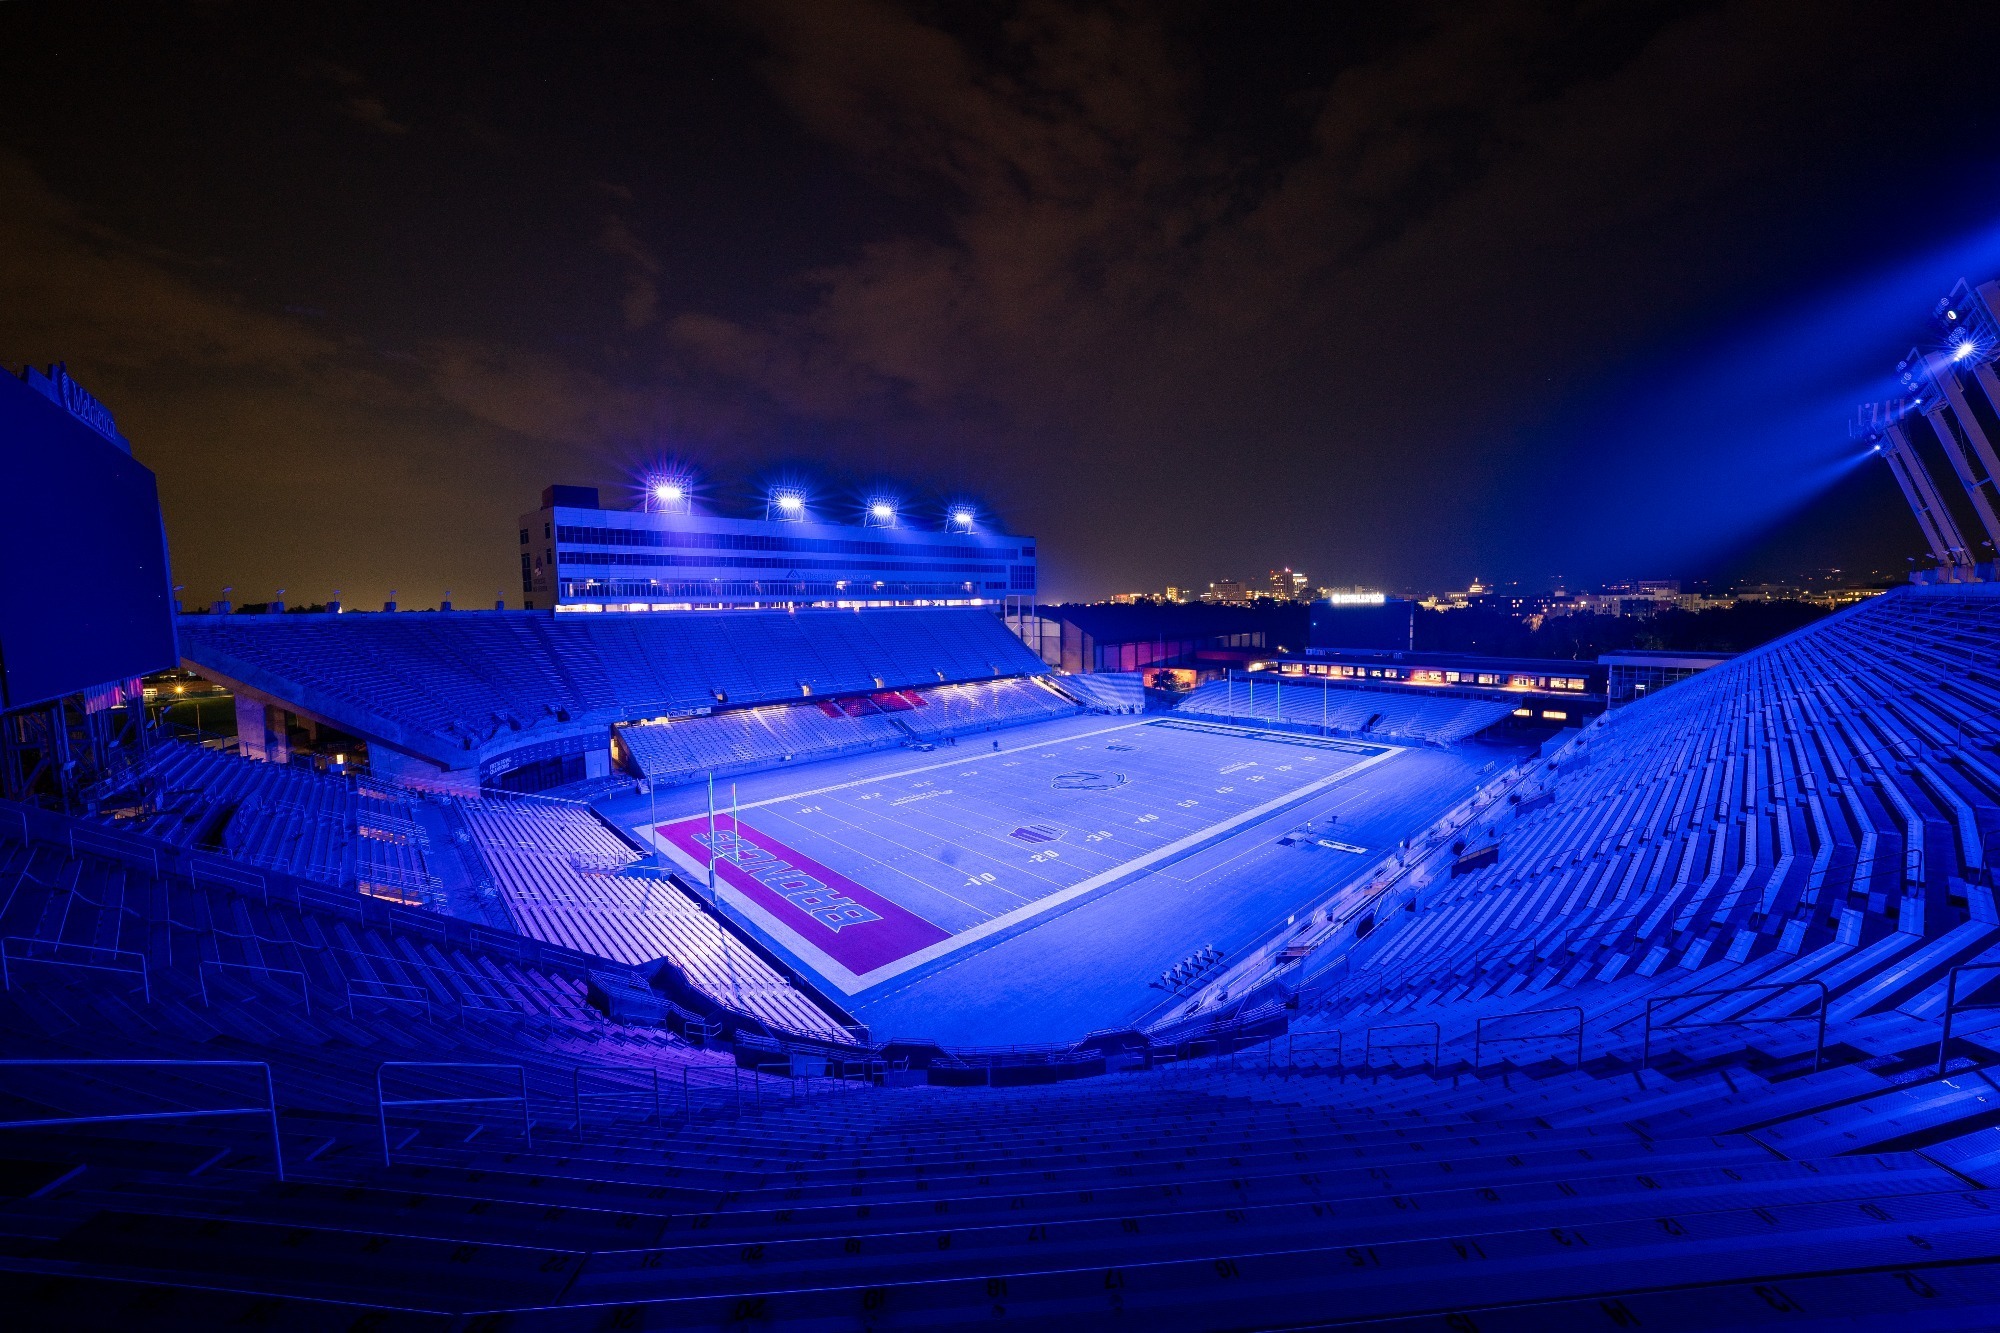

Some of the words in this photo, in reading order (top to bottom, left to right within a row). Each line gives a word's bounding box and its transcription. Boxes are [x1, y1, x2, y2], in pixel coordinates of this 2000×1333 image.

[1136, 812, 1160, 823] 40
[1088, 831, 1114, 843] 30
[1031, 850, 1060, 863] 20
[690, 830, 884, 933] BRONCOS
[966, 872, 997, 886] 10
[1367, 1167, 1391, 1181] 12
[1635, 1174, 1663, 1190] 10
[1162, 1184, 1184, 1198] 15
[1556, 1182, 1579, 1197] 11
[1009, 1197, 1026, 1211] 17
[1311, 1202, 1337, 1217] 14
[1391, 1196, 1421, 1211] 13
[1857, 1202, 1897, 1221] 10
[691, 1214, 714, 1230] 21
[773, 1209, 796, 1223] 20
[1225, 1209, 1247, 1224] 15
[1752, 1205, 1781, 1227] 11
[1027, 1225, 1048, 1242] 17
[1654, 1217, 1691, 1237] 12
[937, 1232, 952, 1251] 18
[1550, 1228, 1591, 1247] 13
[740, 1244, 766, 1262] 20
[844, 1238, 862, 1255] 19
[1450, 1240, 1487, 1261] 14
[540, 1254, 570, 1273] 22
[641, 1252, 665, 1269] 21
[1345, 1247, 1381, 1268] 15
[1214, 1258, 1241, 1279] 16
[1104, 1268, 1125, 1290] 17
[986, 1278, 1008, 1298] 18
[863, 1288, 886, 1311] 19
[1752, 1284, 1806, 1313] 13
[734, 1299, 766, 1322] 20
[1600, 1298, 1643, 1327] 14
